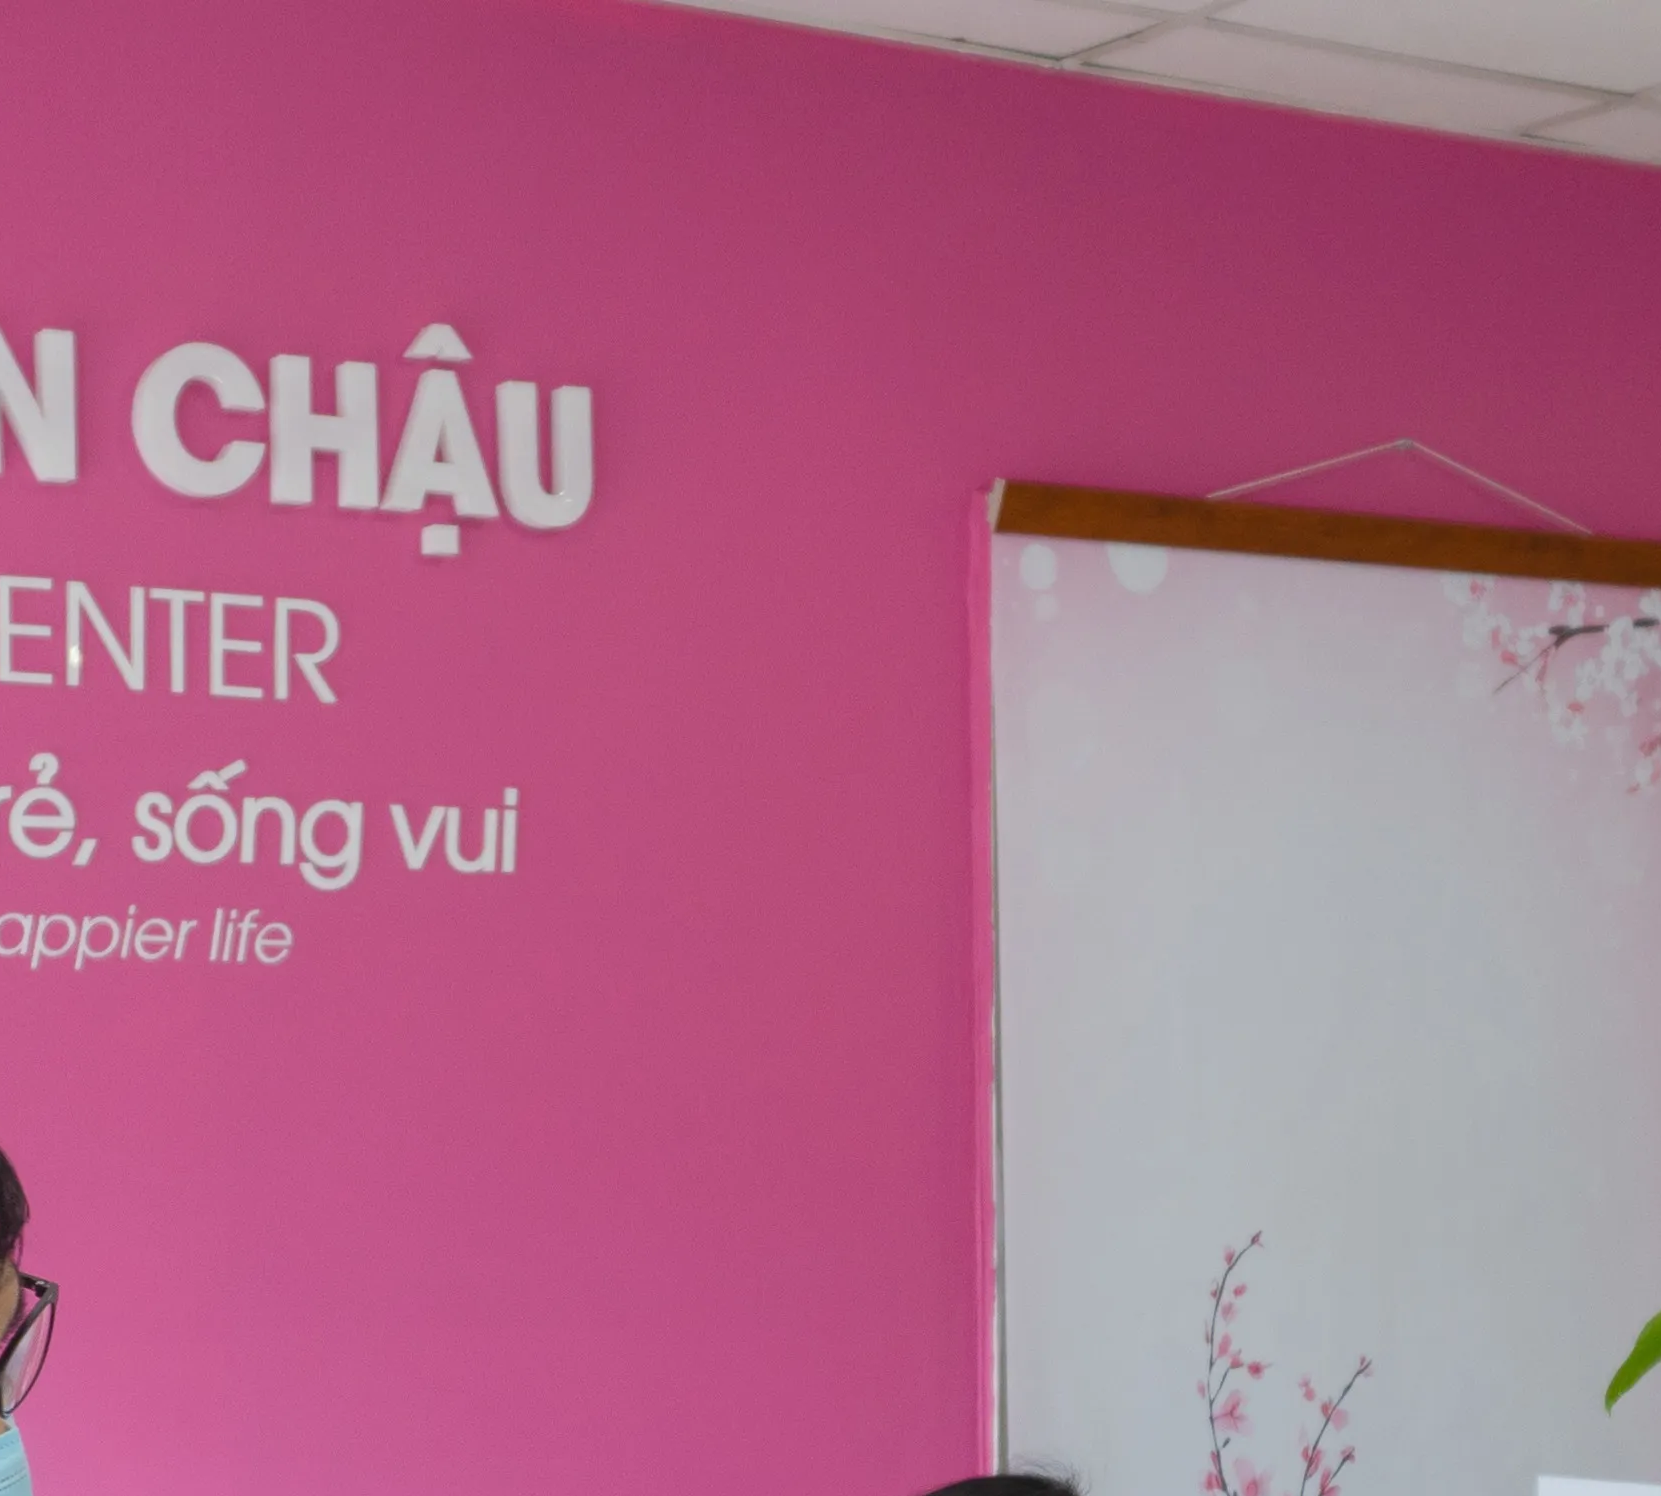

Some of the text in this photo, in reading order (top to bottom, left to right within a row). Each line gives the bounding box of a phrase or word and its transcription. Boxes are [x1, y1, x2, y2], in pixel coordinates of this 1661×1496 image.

[132, 322, 594, 558] CHẬU
[131, 759, 364, 891] sống
[388, 787, 520, 875] vui
[208, 904, 294, 966] life
